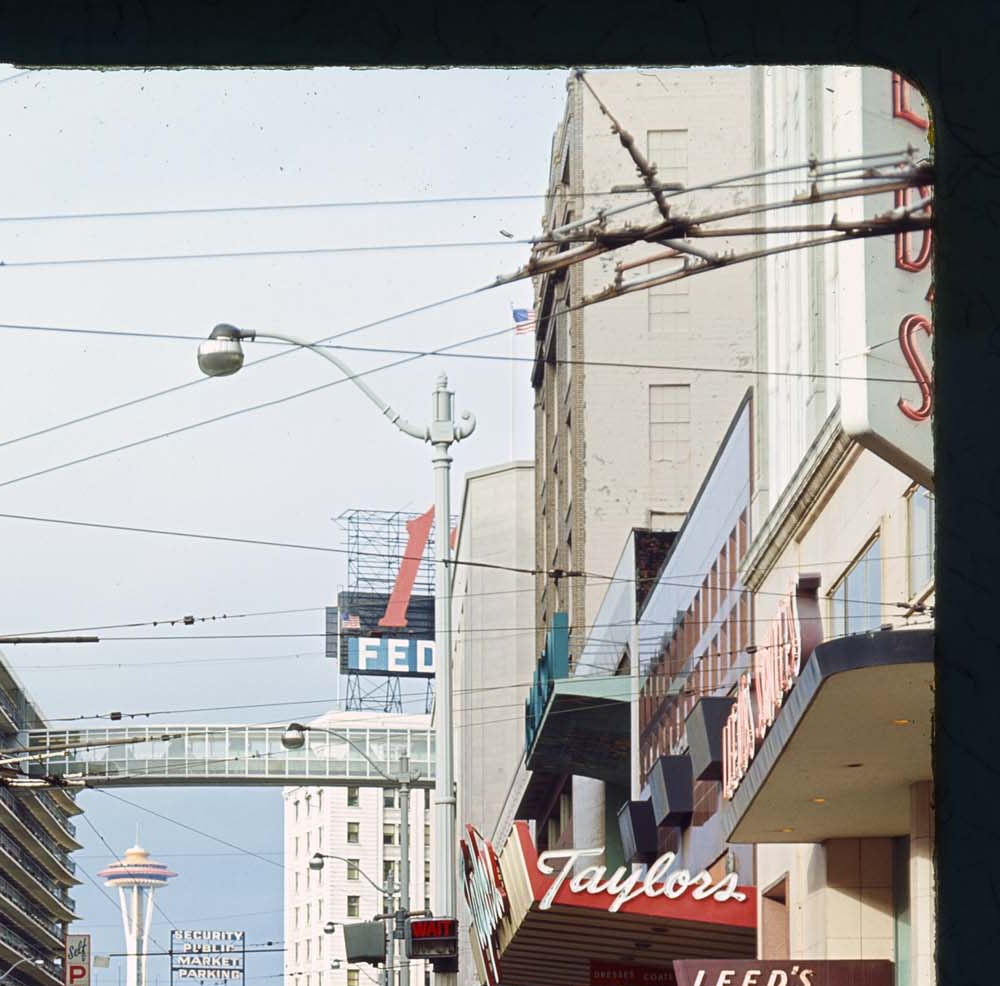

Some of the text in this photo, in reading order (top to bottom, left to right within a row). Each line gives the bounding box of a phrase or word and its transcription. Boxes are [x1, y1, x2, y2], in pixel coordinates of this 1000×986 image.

[536, 846, 747, 913] Taylors
[413, 920, 449, 936] WAIT
[173, 930, 244, 941] SECURITY
[68, 937, 87, 962] Self
[183, 943, 235, 954] PUBLIC
[178, 956, 240, 967] MARKET
[178, 969, 241, 980] PARKING
